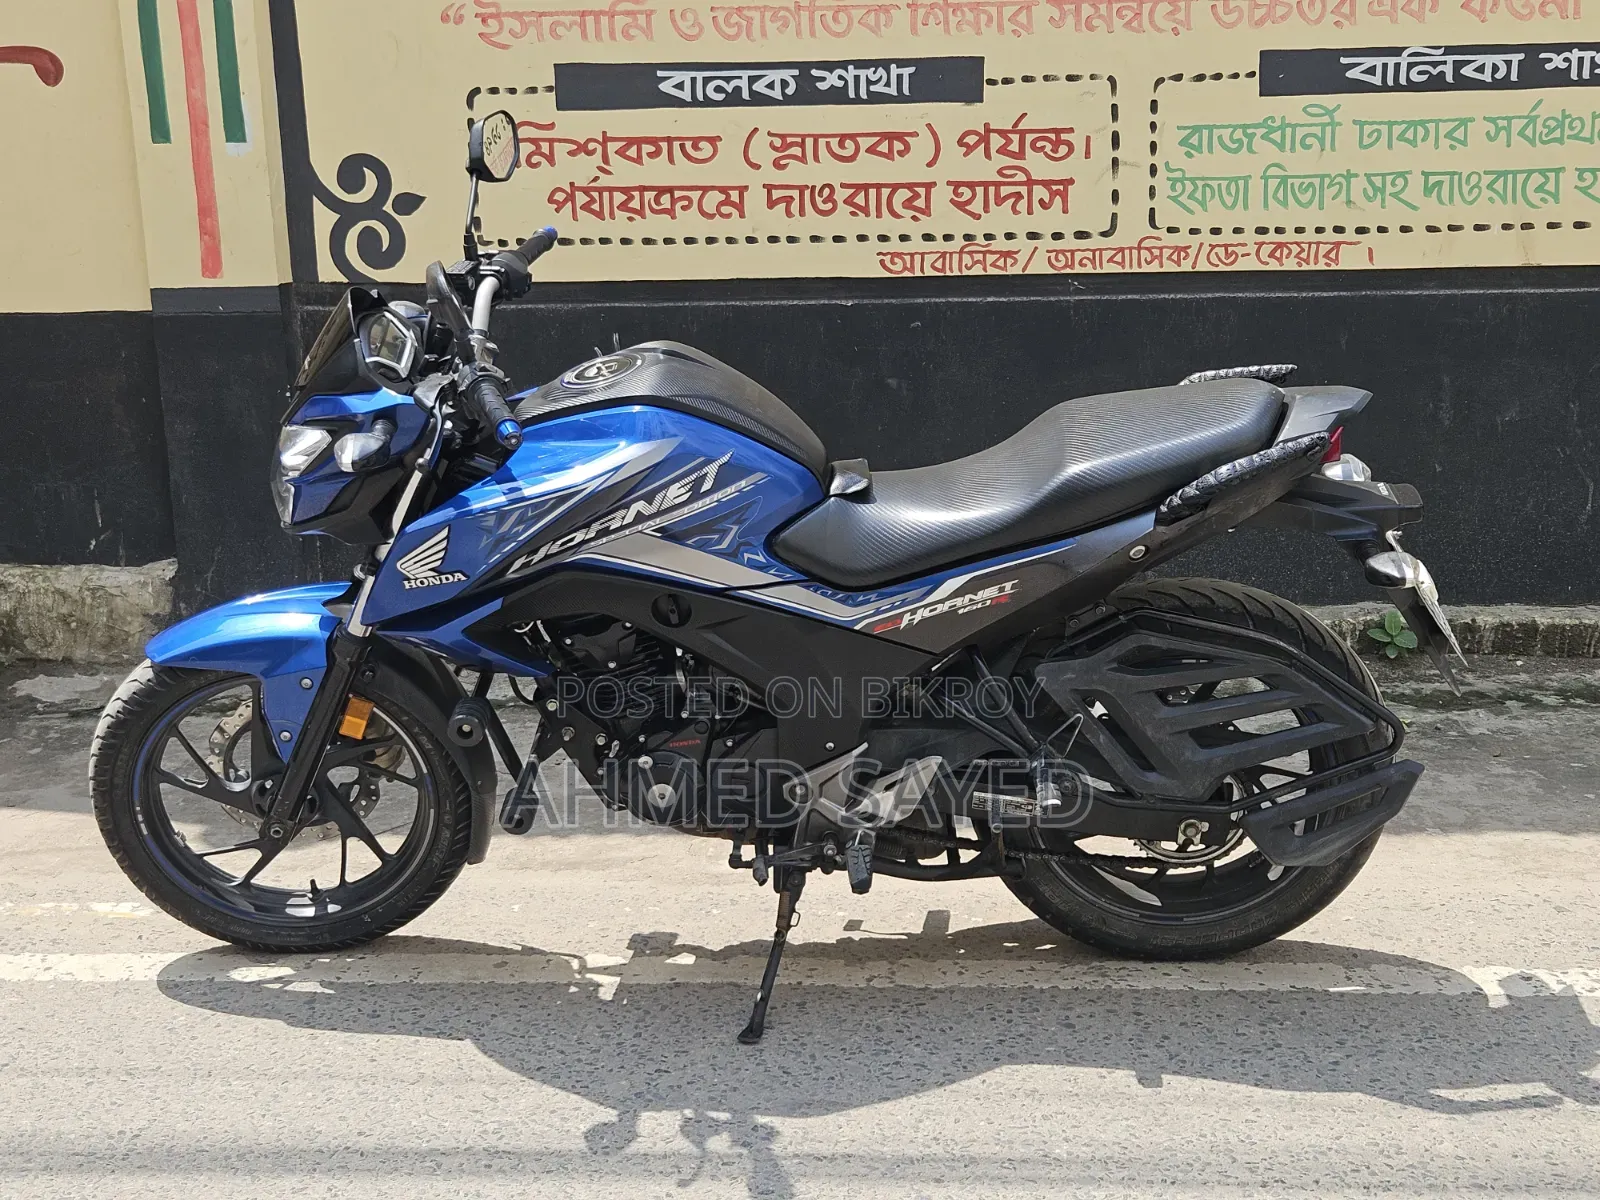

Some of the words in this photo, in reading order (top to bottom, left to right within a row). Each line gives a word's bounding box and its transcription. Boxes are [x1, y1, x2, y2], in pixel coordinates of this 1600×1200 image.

[670, 7, 704, 41] ও
[656, 69, 799, 101] বালক
[811, 64, 917, 99] শাখা
[1340, 47, 1525, 86] বালিকা
[1539, 48, 1600, 80] শা
[1176, 103, 1343, 159] রাজধানী
[1352, 116, 1475, 151] ঢাকার
[1483, 98, 1600, 148] সর্বপ্রথ
[762, 181, 937, 223] দাওরায়ে
[946, 165, 1076, 221] হাদীস
[1164, 161, 1252, 215] ইফতা
[1260, 162, 1360, 211] বিভাগ
[1362, 170, 1420, 212] সহ
[506, 450, 735, 576] HORNET
[403, 571, 468, 590] HONDA
[900, 579, 1020, 631] HORNET
